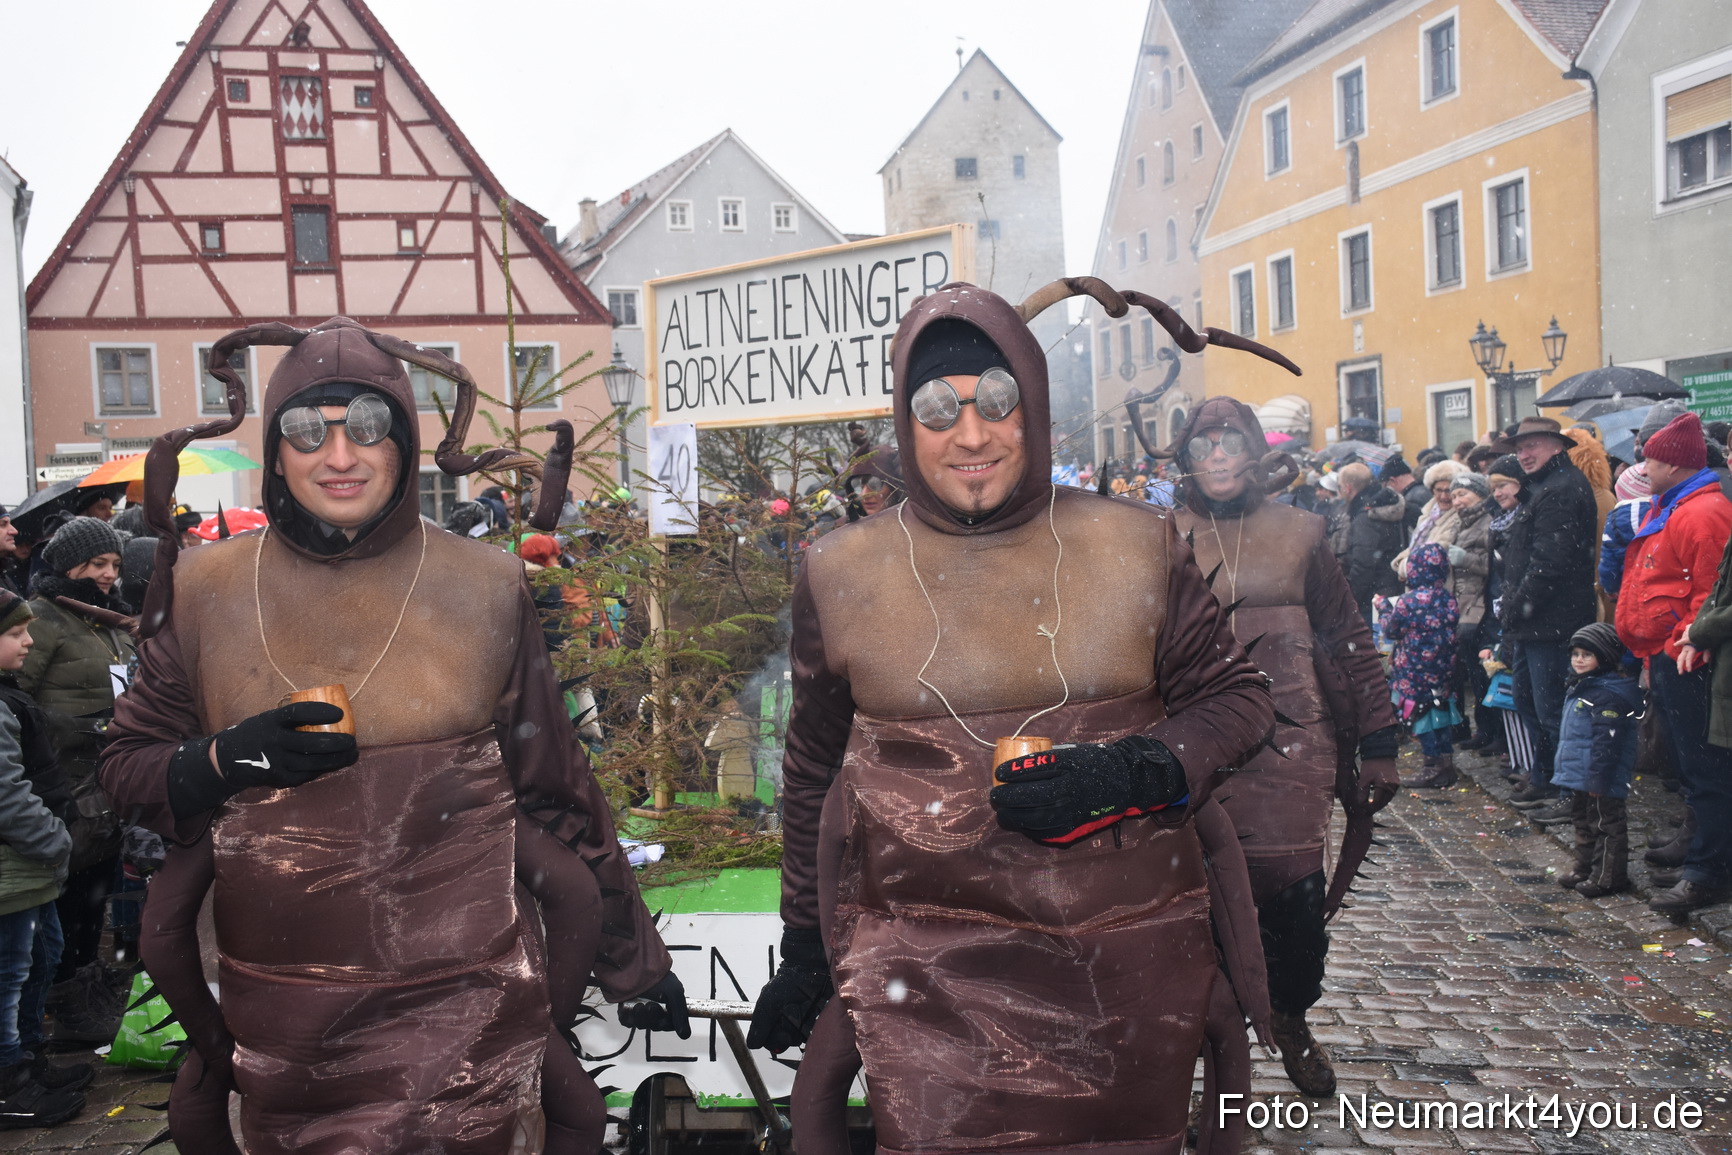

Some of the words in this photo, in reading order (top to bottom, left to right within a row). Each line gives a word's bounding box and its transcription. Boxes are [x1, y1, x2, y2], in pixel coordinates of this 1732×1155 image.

[1683, 377, 1693, 386] ZU
[1446, 395, 1466, 408] BW
[658, 443, 690, 493] 40
[1011, 754, 1057, 771] LEKI
